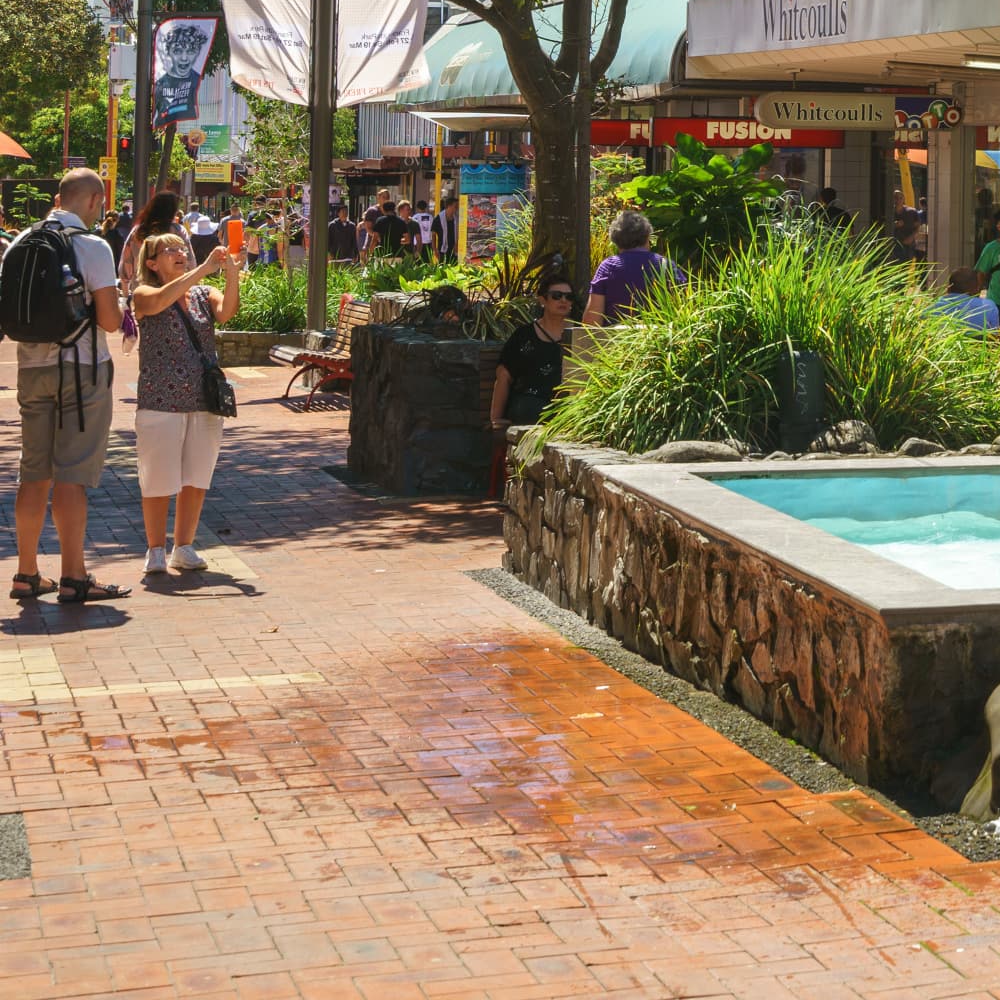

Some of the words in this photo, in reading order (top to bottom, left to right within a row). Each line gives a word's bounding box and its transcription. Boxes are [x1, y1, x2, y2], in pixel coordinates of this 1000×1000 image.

[773, 101, 883, 122] Whitcoulls
[895, 102, 960, 129] LOTTO
[706, 121, 792, 140] FUSION
